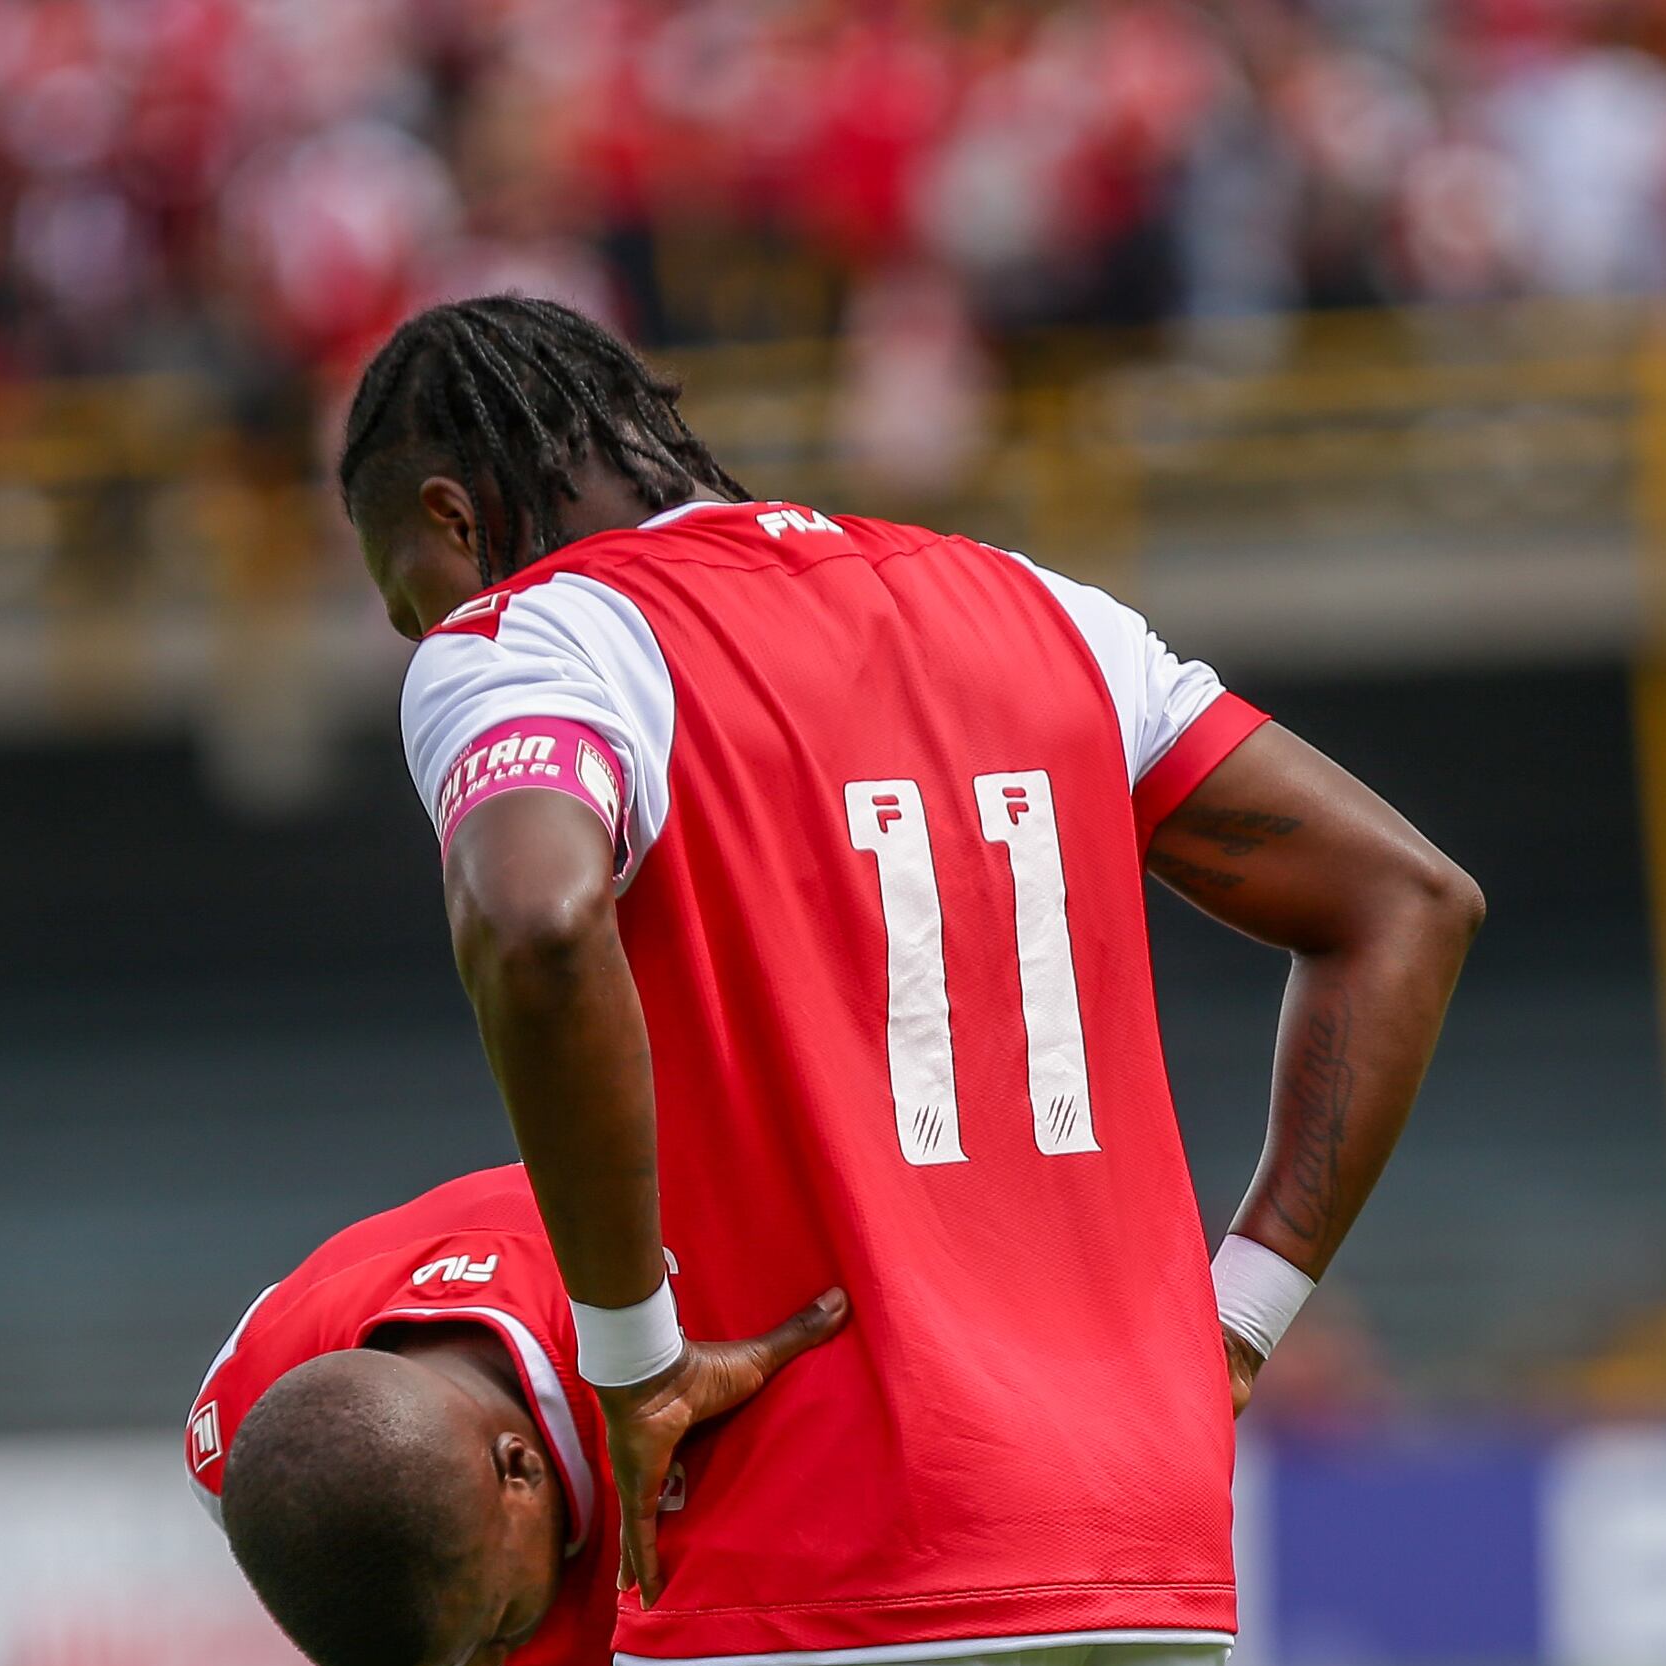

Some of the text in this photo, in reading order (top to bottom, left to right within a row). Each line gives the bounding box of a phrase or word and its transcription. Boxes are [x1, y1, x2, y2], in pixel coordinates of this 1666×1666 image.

[755, 508, 845, 540] FILA
[494, 764, 525, 782] LA
[843, 768, 1103, 1167] 11
[412, 1254, 500, 1286] FILA
